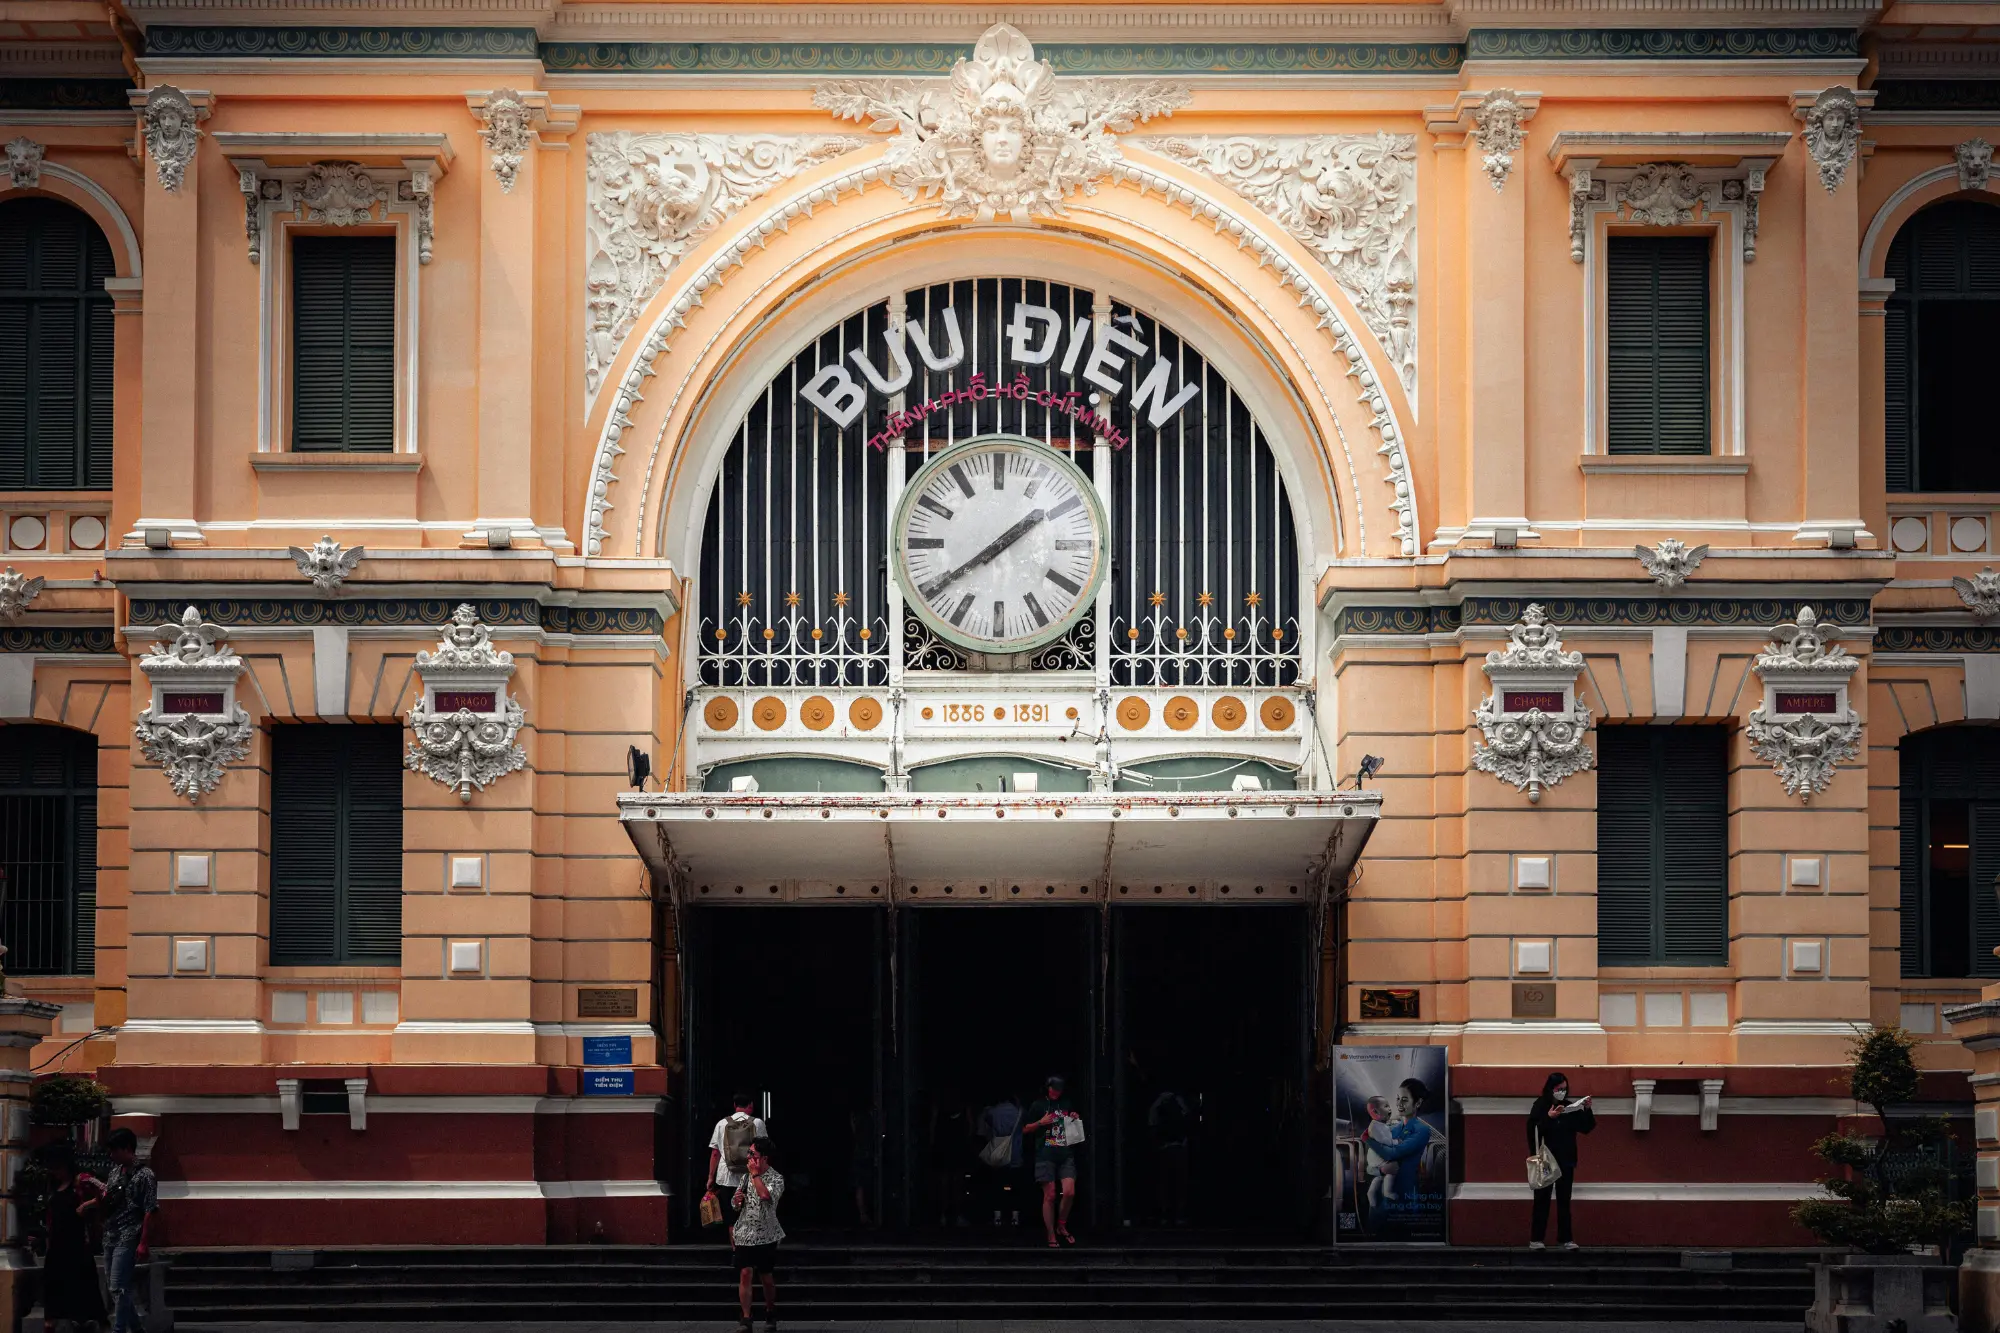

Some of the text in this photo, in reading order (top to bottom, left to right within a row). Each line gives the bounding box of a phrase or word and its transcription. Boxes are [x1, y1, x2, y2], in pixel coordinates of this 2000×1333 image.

[1006, 302, 1200, 431] ĐIỆN
[867, 371, 1130, 453] THÀNH PHỐ HỒ CHÍ MINH
[454, 696, 488, 707] ARAGO
[1514, 696, 1553, 707] CHAPPE
[943, 704, 1049, 723] 1886 1891
